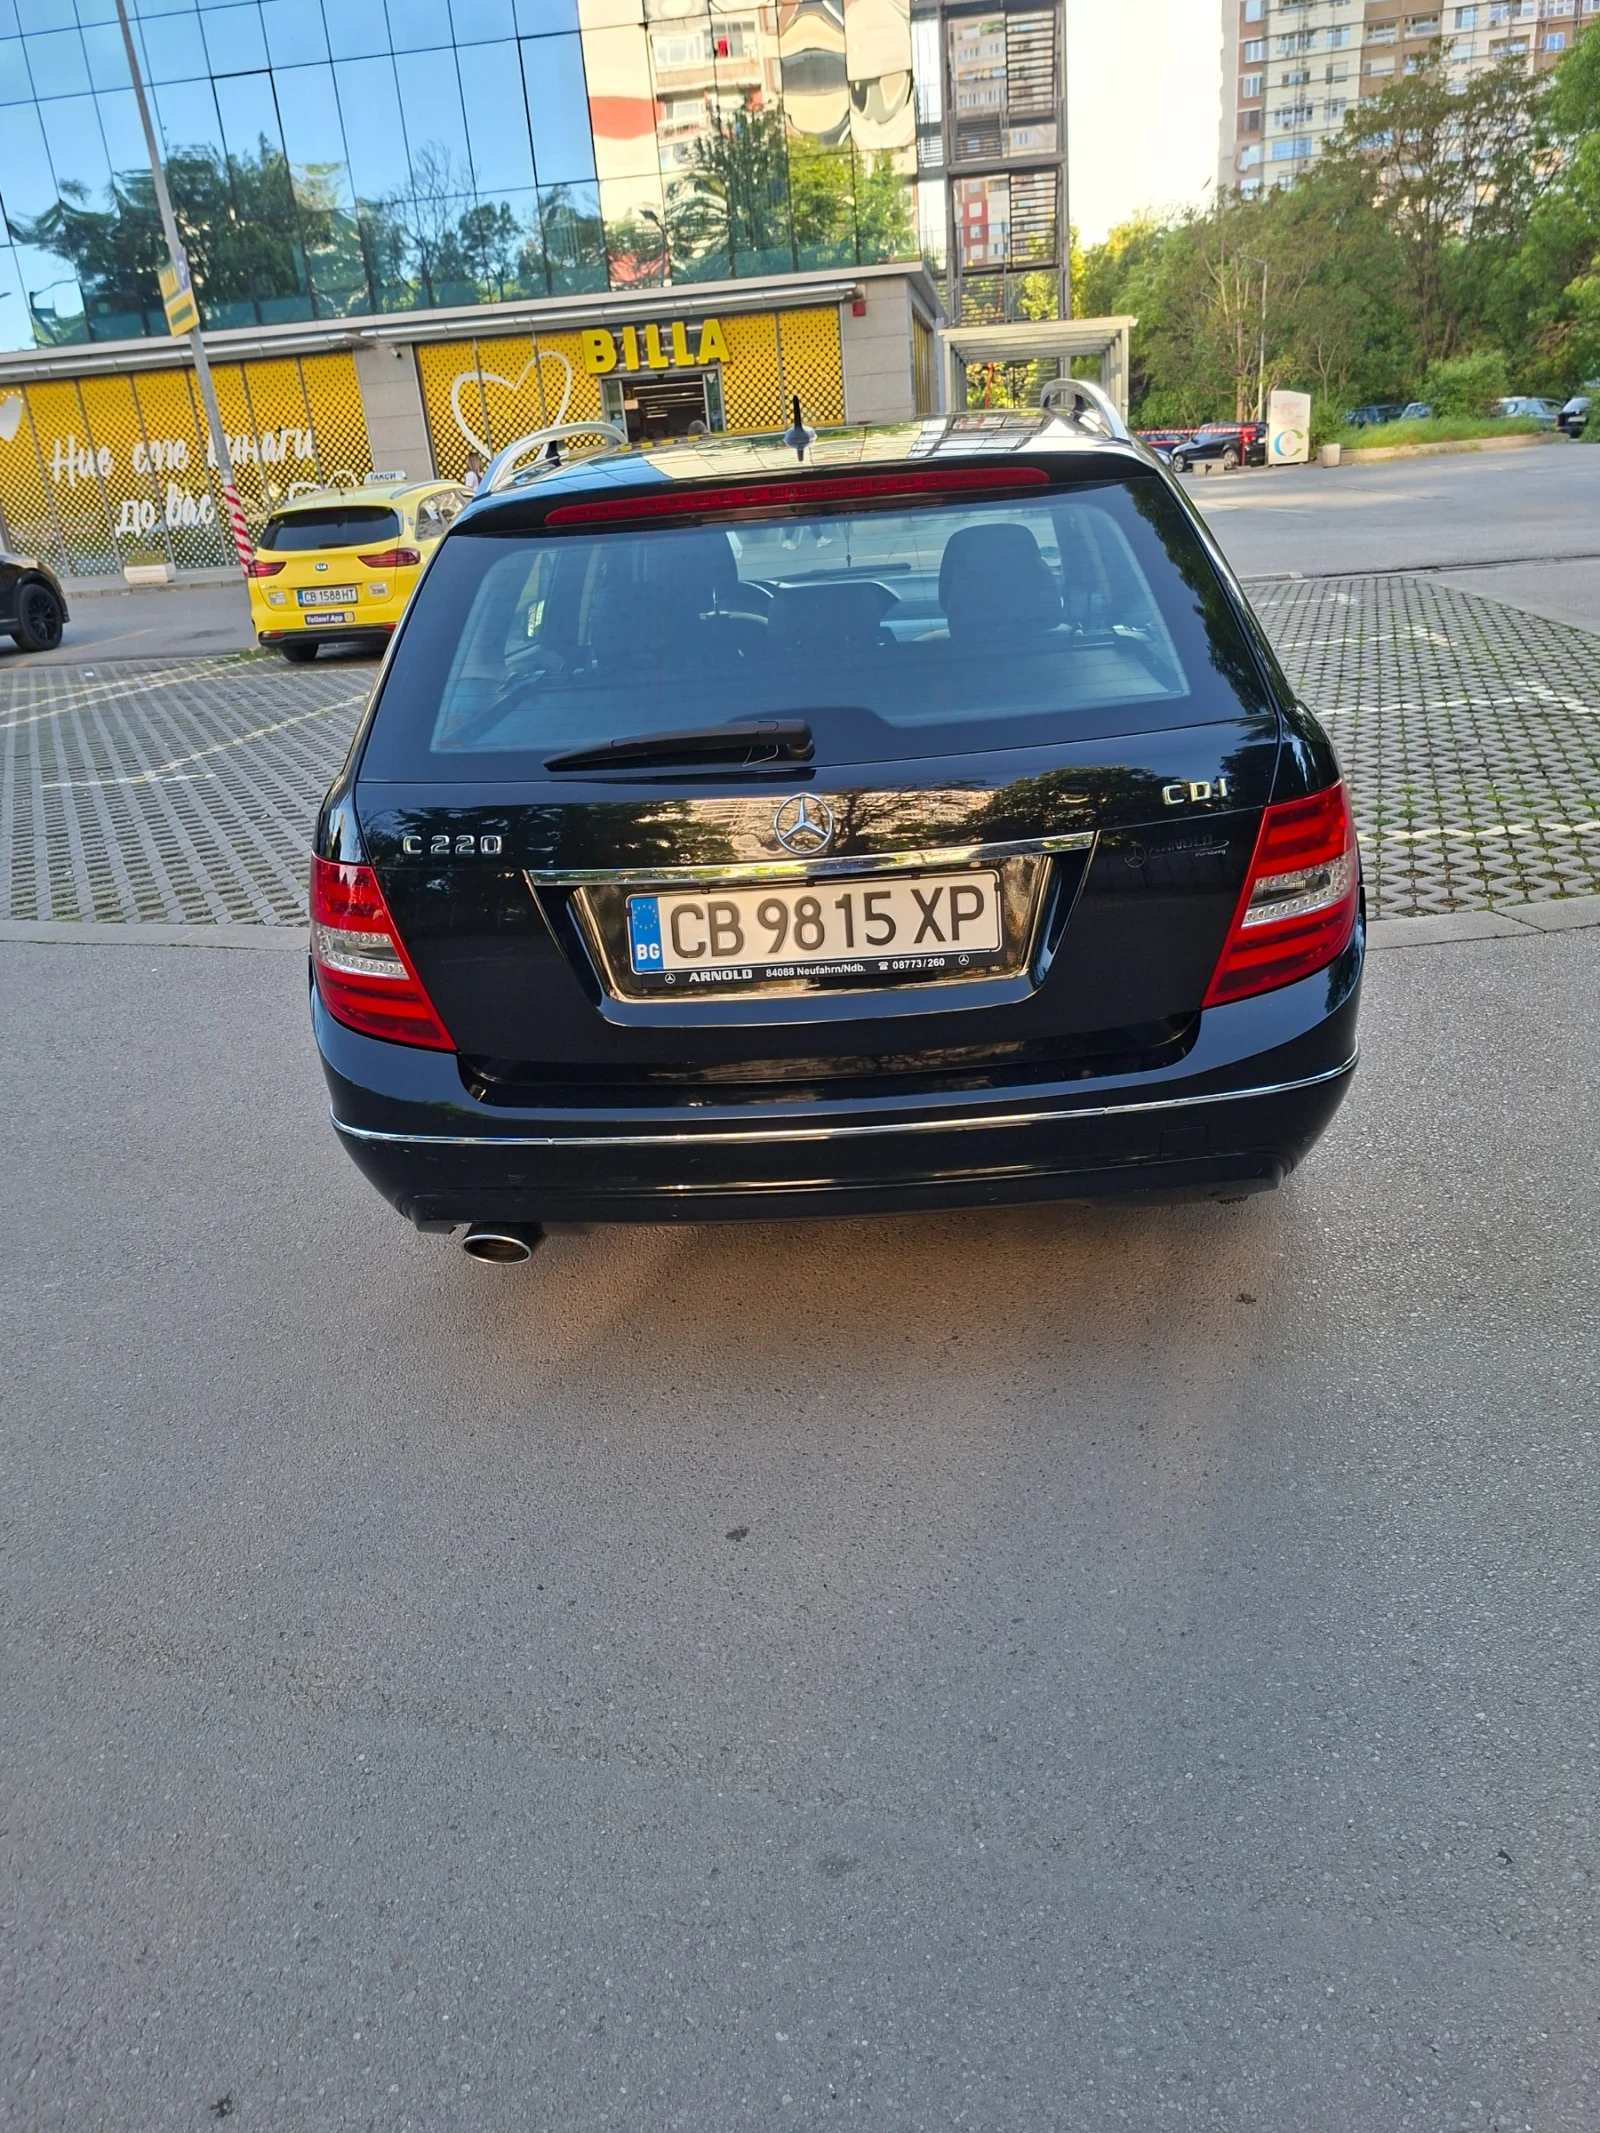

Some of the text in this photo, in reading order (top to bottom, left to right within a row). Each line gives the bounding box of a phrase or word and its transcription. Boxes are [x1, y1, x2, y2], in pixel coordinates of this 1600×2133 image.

[582, 319, 731, 374] BILLA
[370, 472, 396, 481] ТАКСИ
[316, 563, 328, 571] KIA
[304, 589, 354, 603] CB 1588 HT
[1162, 778, 1228, 806] CDI
[670, 885, 985, 959] CB 9815 XP
[636, 943, 660, 960] BG
[688, 969, 753, 983] ARNOLD
[766, 967, 795, 978] 84088
[798, 964, 866, 976] Neufahrn/Ndb.
